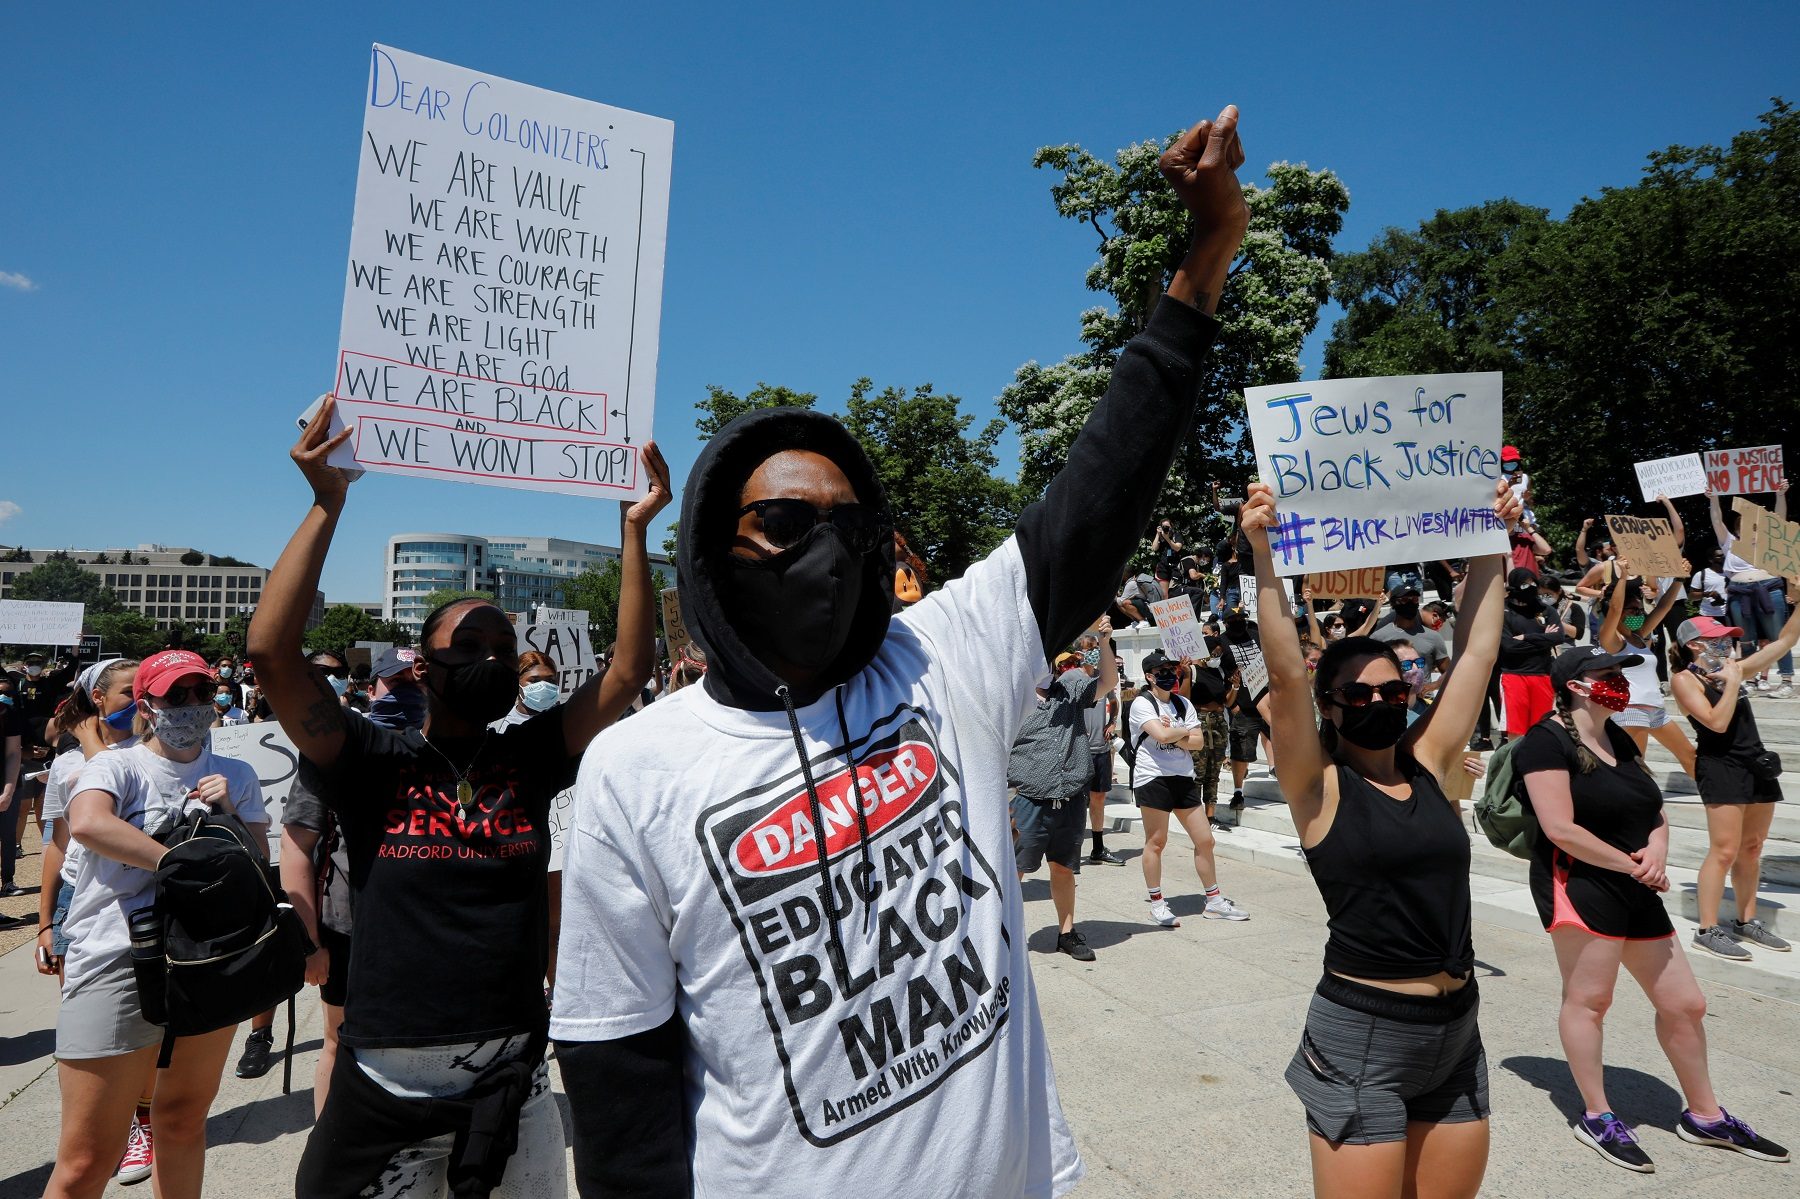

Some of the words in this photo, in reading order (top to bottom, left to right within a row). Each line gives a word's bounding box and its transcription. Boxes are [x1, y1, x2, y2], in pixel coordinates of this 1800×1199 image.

[371, 49, 451, 121] DEAR
[368, 131, 428, 184] WE
[447, 150, 498, 203] ARE
[513, 166, 586, 220] VALUE
[410, 193, 447, 231] WE
[455, 205, 504, 241] ARE
[517, 219, 608, 264] WORTH
[385, 229, 425, 261] WE
[436, 242, 489, 277] ARE
[499, 254, 606, 300] COURAGE
[351, 259, 393, 296] WE
[403, 274, 454, 307] ARE
[473, 284, 597, 330] STRENGTH
[376, 304, 417, 337] WE
[427, 312, 473, 343] ARE
[484, 320, 558, 361] LIGHT
[405, 342, 447, 370] WE
[456, 350, 507, 384] ARE
[344, 361, 400, 404] WE
[415, 374, 477, 416] ARE
[494, 386, 599, 432] BLACK
[454, 418, 487, 434] AND
[1265, 392, 1393, 444] Jews
[1408, 386, 1467, 428] for
[374, 422, 431, 465] WE
[450, 431, 544, 476] WONT
[558, 443, 629, 485] STOP!
[1268, 446, 1392, 499] Black
[1392, 440, 1499, 481] Justice
[1707, 469, 1731, 493] NO
[1737, 463, 1785, 494] PEACE
[1708, 452, 1730, 468] NO
[1733, 447, 1783, 466] JUSTICE
[1310, 565, 1385, 595] JUSTICE
[548, 609, 577, 621] WHITE
[1168, 625, 1182, 637] NO
[524, 626, 581, 666] SAY
[385, 808, 533, 840] SERVICE
[752, 748, 930, 868] DANGER
[378, 844, 454, 860] RADFORD
[456, 839, 537, 860] UNIVERSITY
[748, 800, 964, 955] EDUCATED
[771, 861, 991, 1026] BLACK
[838, 935, 993, 1081] MAN
[822, 1070, 892, 1127] Armed
[889, 1045, 940, 1087] With
